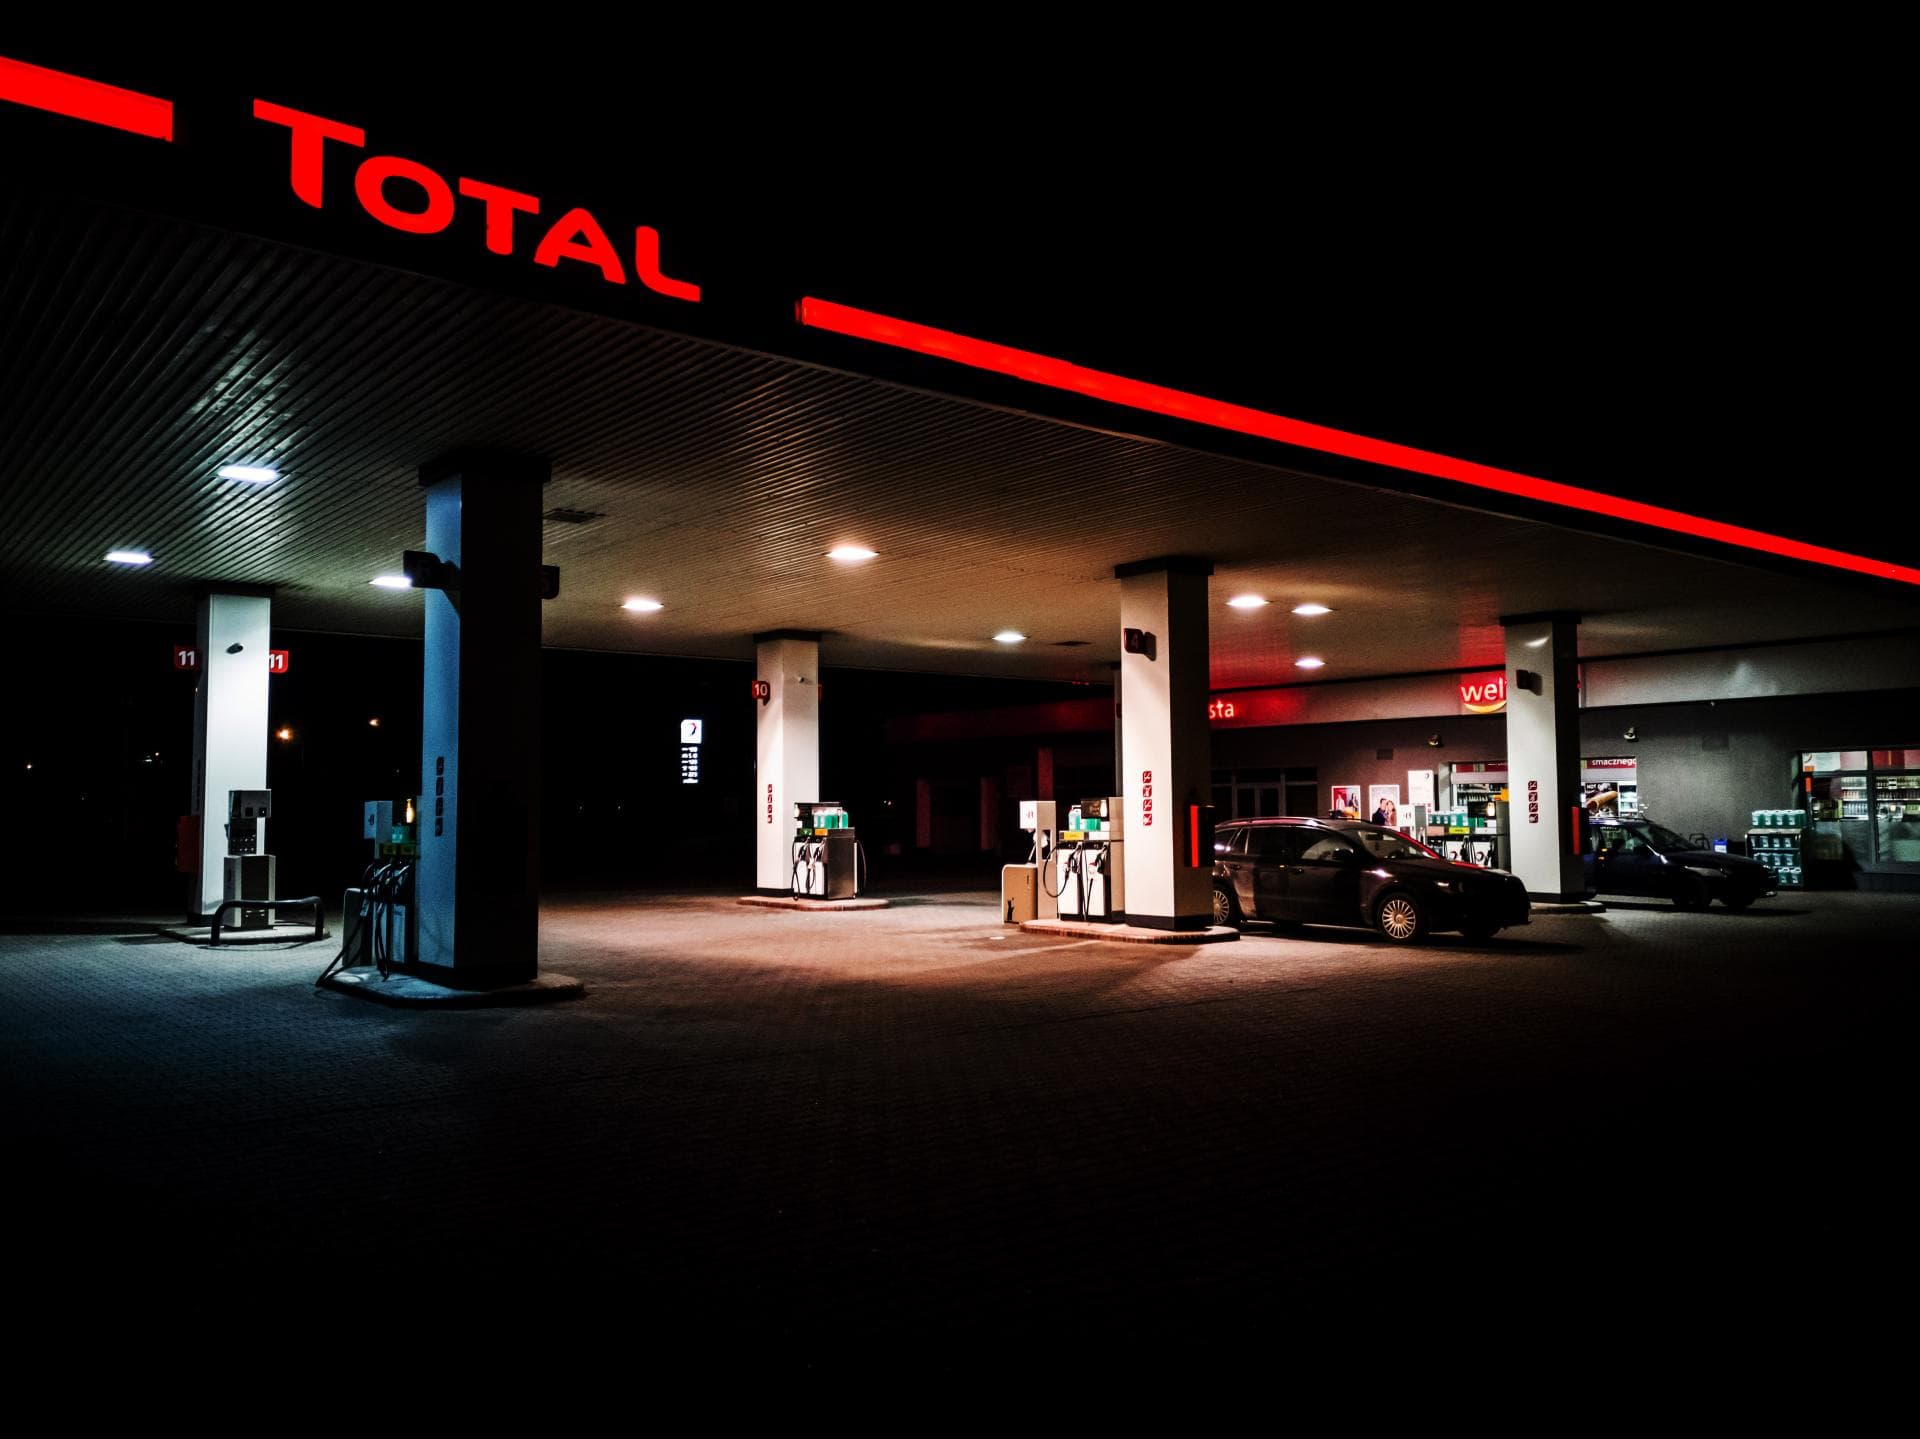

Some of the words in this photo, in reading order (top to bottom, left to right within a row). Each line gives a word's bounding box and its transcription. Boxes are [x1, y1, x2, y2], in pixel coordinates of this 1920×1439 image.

[253, 98, 701, 303] TOTAL
[178, 650, 195, 666] 11
[269, 653, 284, 670] 11
[754, 683, 769, 697] 10
[1461, 677, 1506, 702] wel
[1209, 698, 1235, 720] sta
